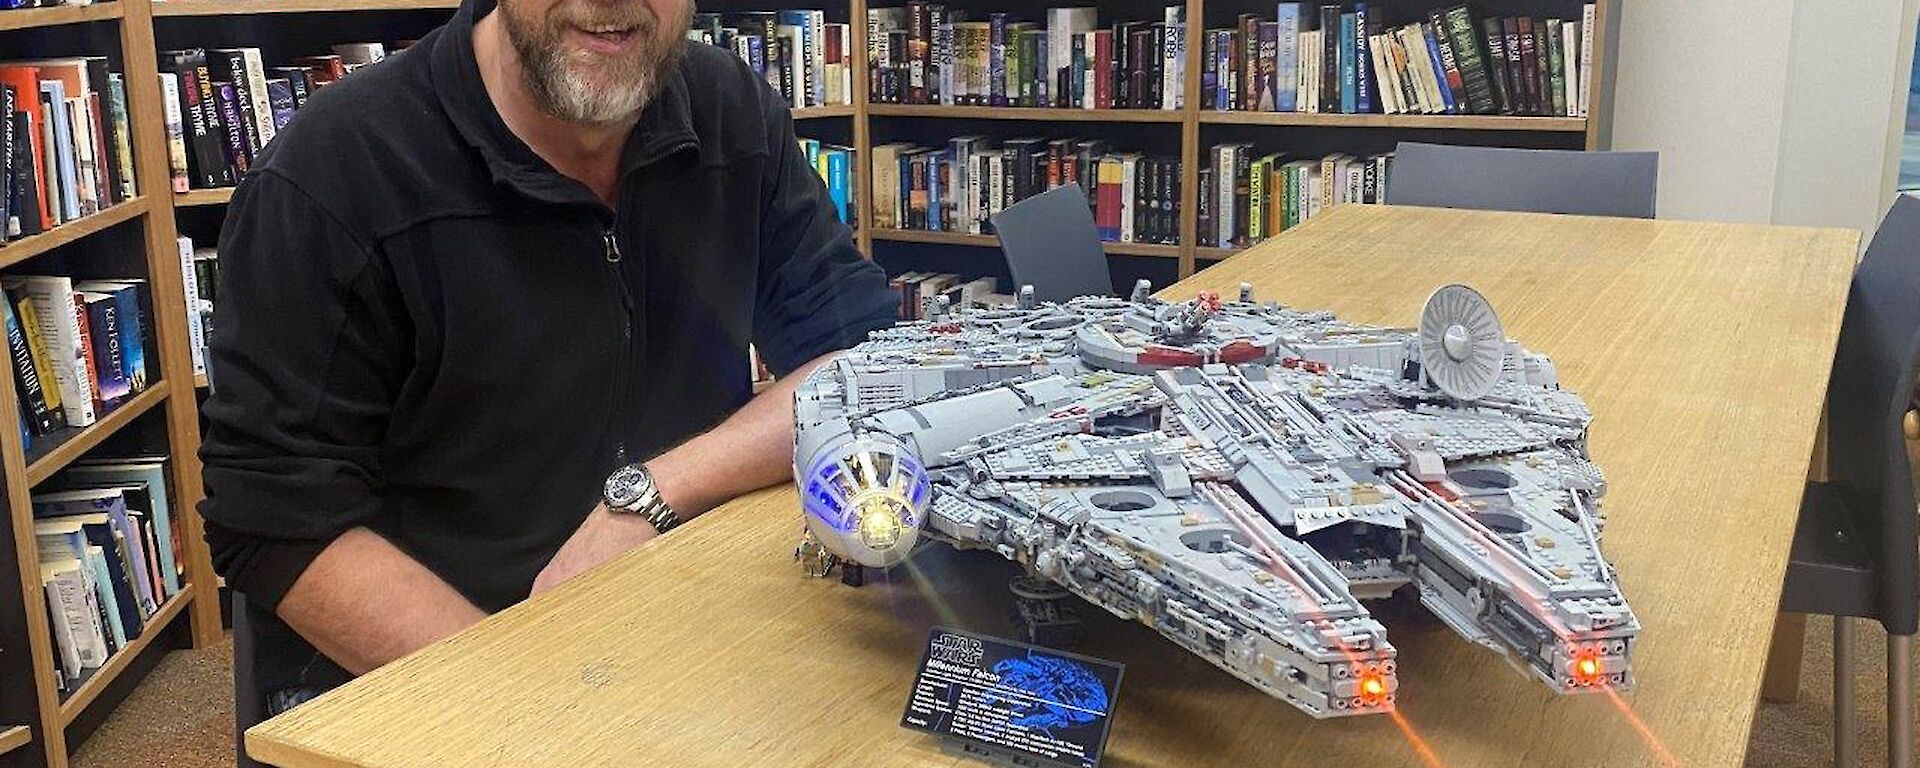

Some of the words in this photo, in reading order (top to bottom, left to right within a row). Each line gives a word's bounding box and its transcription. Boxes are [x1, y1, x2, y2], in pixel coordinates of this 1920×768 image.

[1356, 11, 1366, 50] CASSIDY
[931, 633, 983, 651] STAR
[931, 643, 984, 667] WARS
[926, 658, 971, 676] Millennium
[971, 667, 1001, 682] Falcon
